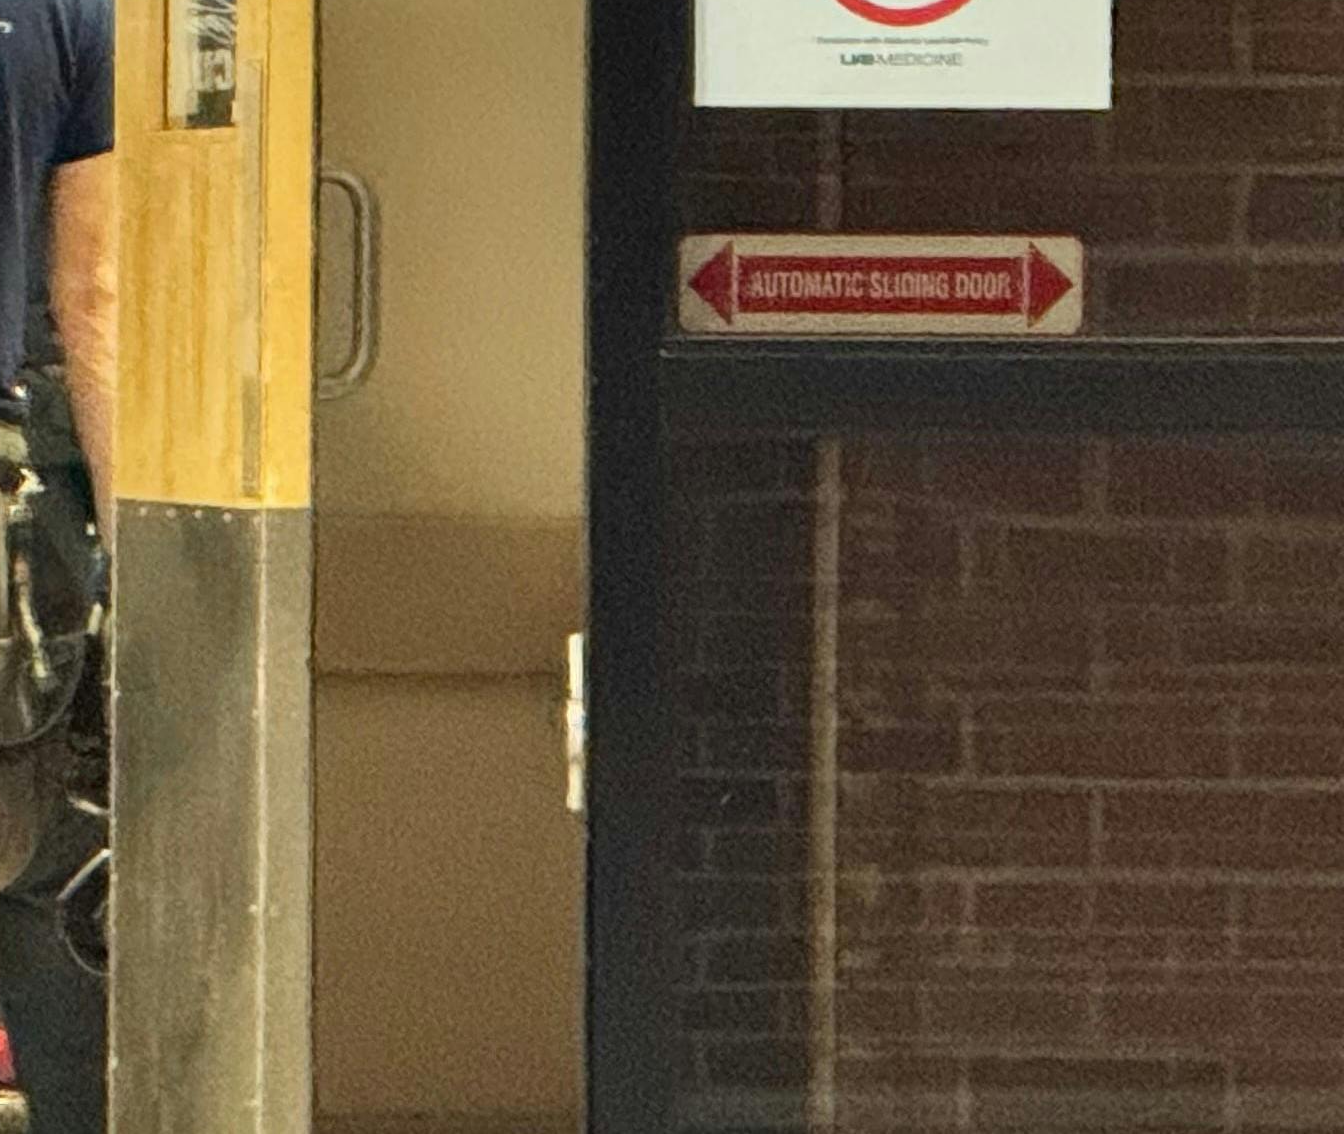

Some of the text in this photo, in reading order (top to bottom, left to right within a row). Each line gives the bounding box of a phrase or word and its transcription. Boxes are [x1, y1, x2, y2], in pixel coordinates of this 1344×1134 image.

[749, 270, 1012, 300] AUTOMATIC SLIDING DOOR
